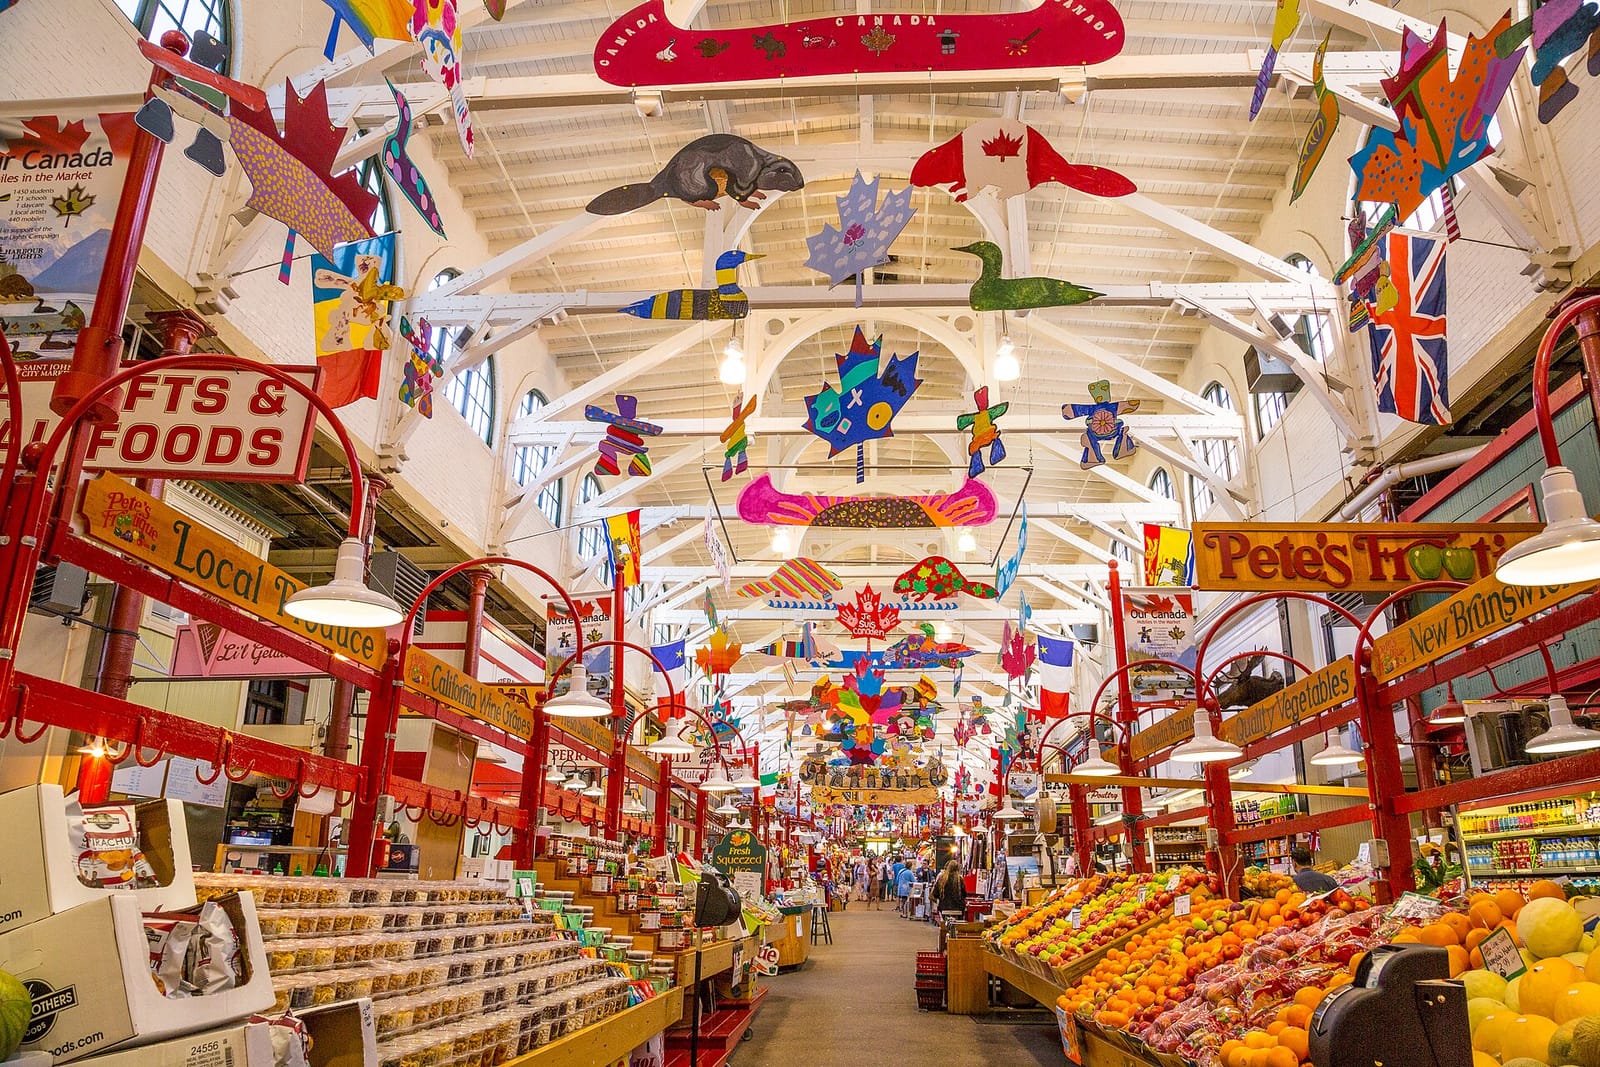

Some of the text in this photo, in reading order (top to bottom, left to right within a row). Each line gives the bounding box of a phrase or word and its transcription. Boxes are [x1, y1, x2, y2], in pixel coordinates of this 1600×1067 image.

[835, 15, 936, 27] CANADA
[1054, 0, 1117, 40] ANADA
[599, 13, 658, 66] CANADA
[22, 147, 114, 170] Canada
[22, 173, 32, 182] in
[35, 172, 53, 182] the
[55, 170, 93, 181] Market
[6, 247, 44, 255] HARBOUR
[248, 377, 288, 418] &
[84, 421, 286, 468] FOODS
[107, 491, 152, 521] Pete's
[172, 519, 266, 606] Local
[1203, 532, 1353, 589] Pete's
[548, 613, 610, 626] Notre anada
[860, 612, 872, 620] Je
[1130, 609, 1187, 619] Our Canada
[1409, 616, 1449, 662] New
[431, 664, 477, 712] California
[480, 687, 501, 722] Wine
[502, 702, 532, 737] Grapes
[1234, 667, 1350, 742] Quality Vegetables
[1090, 790, 1119, 801] Poultry
[716, 855, 762, 866] Squeezed
[729, 847, 751, 855] Fresh
[31, 991, 73, 1016] OTHERS
[24, 1021, 48, 1037] OODS
[190, 1040, 219, 1056] 24556
